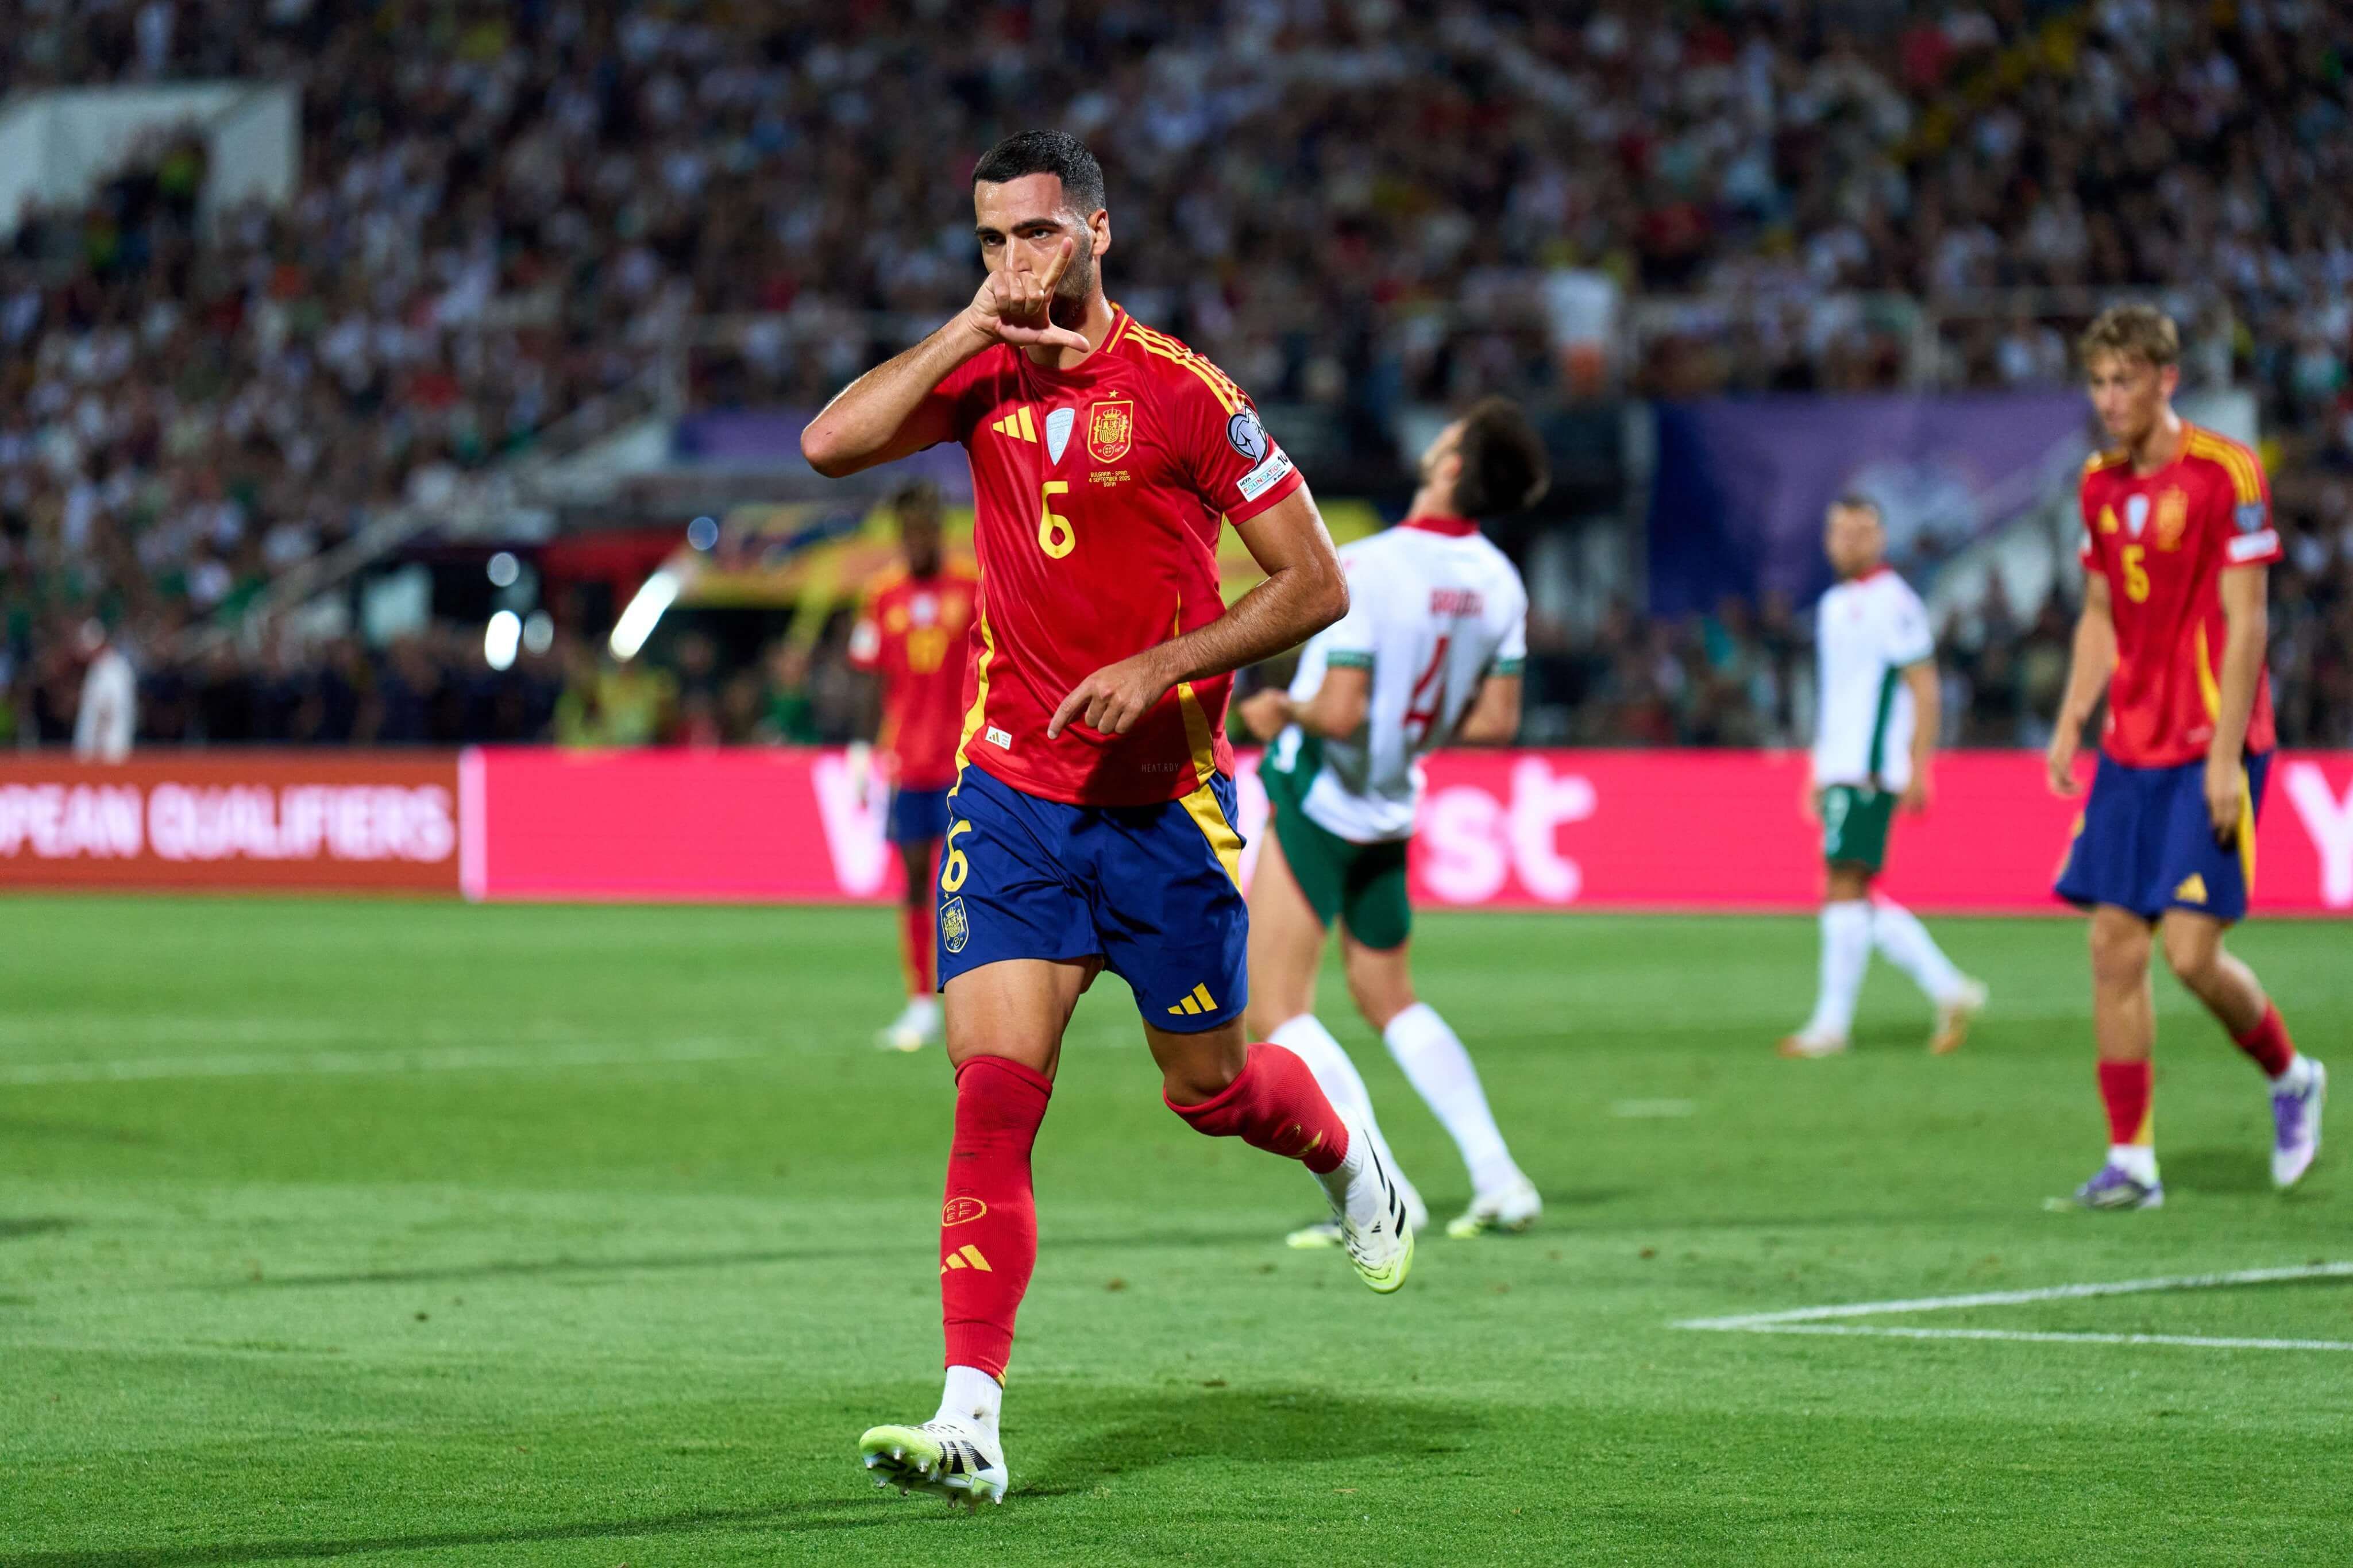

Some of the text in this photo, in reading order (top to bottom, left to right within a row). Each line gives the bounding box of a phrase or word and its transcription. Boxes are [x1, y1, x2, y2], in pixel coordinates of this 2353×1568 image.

[1240, 477, 1251, 486] UEFA
[1243, 463, 1282, 493] FOUNDATION
[1038, 481, 1076, 559] 6
[1402, 635, 1449, 746] 4
[1141, 762, 1179, 773] HEAT.RDY
[148, 782, 454, 861] QUALIFIERS
[941, 819, 972, 892] 6
